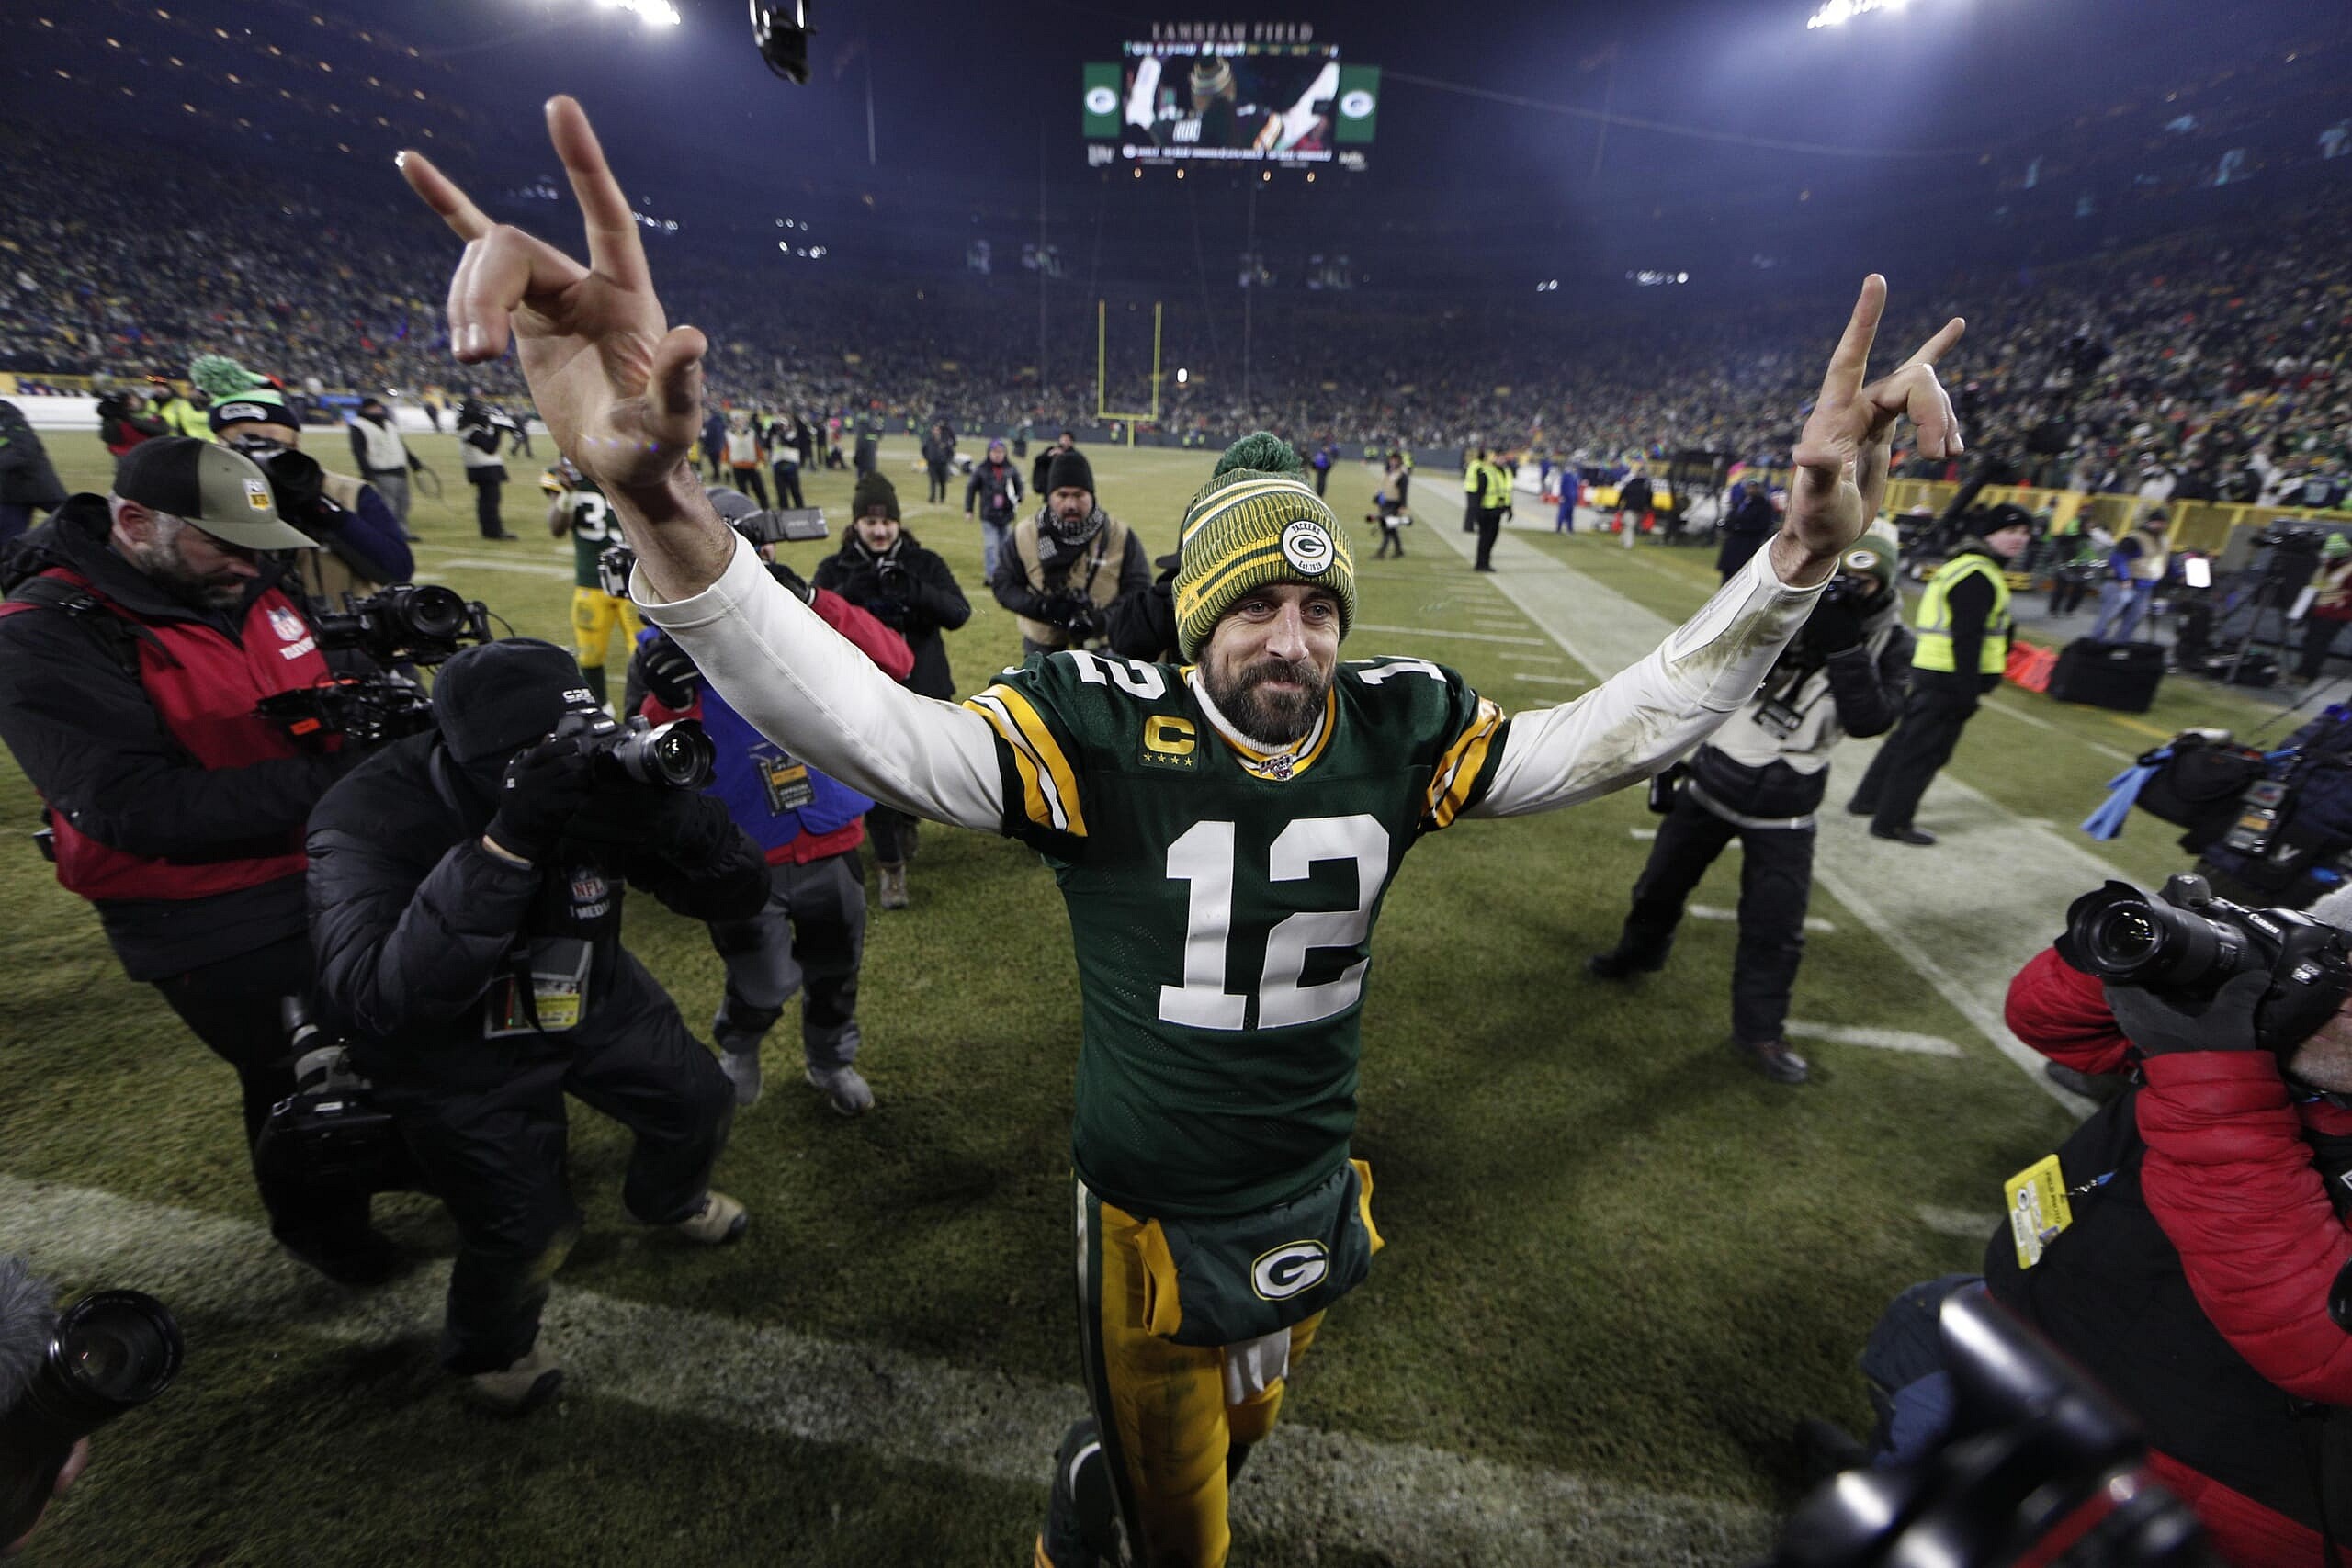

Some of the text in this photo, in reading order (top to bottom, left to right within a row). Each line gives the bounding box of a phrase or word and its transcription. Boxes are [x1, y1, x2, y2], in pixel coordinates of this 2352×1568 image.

[1254, 22, 1313, 42] FIELD
[571, 491, 624, 543] 3
[1291, 522, 1321, 535] PACKERS
[1145, 716, 1194, 755] C
[1158, 813, 1391, 1030] 12
[2248, 913, 2281, 934] Canon
[1252, 1241, 1329, 1299] G
